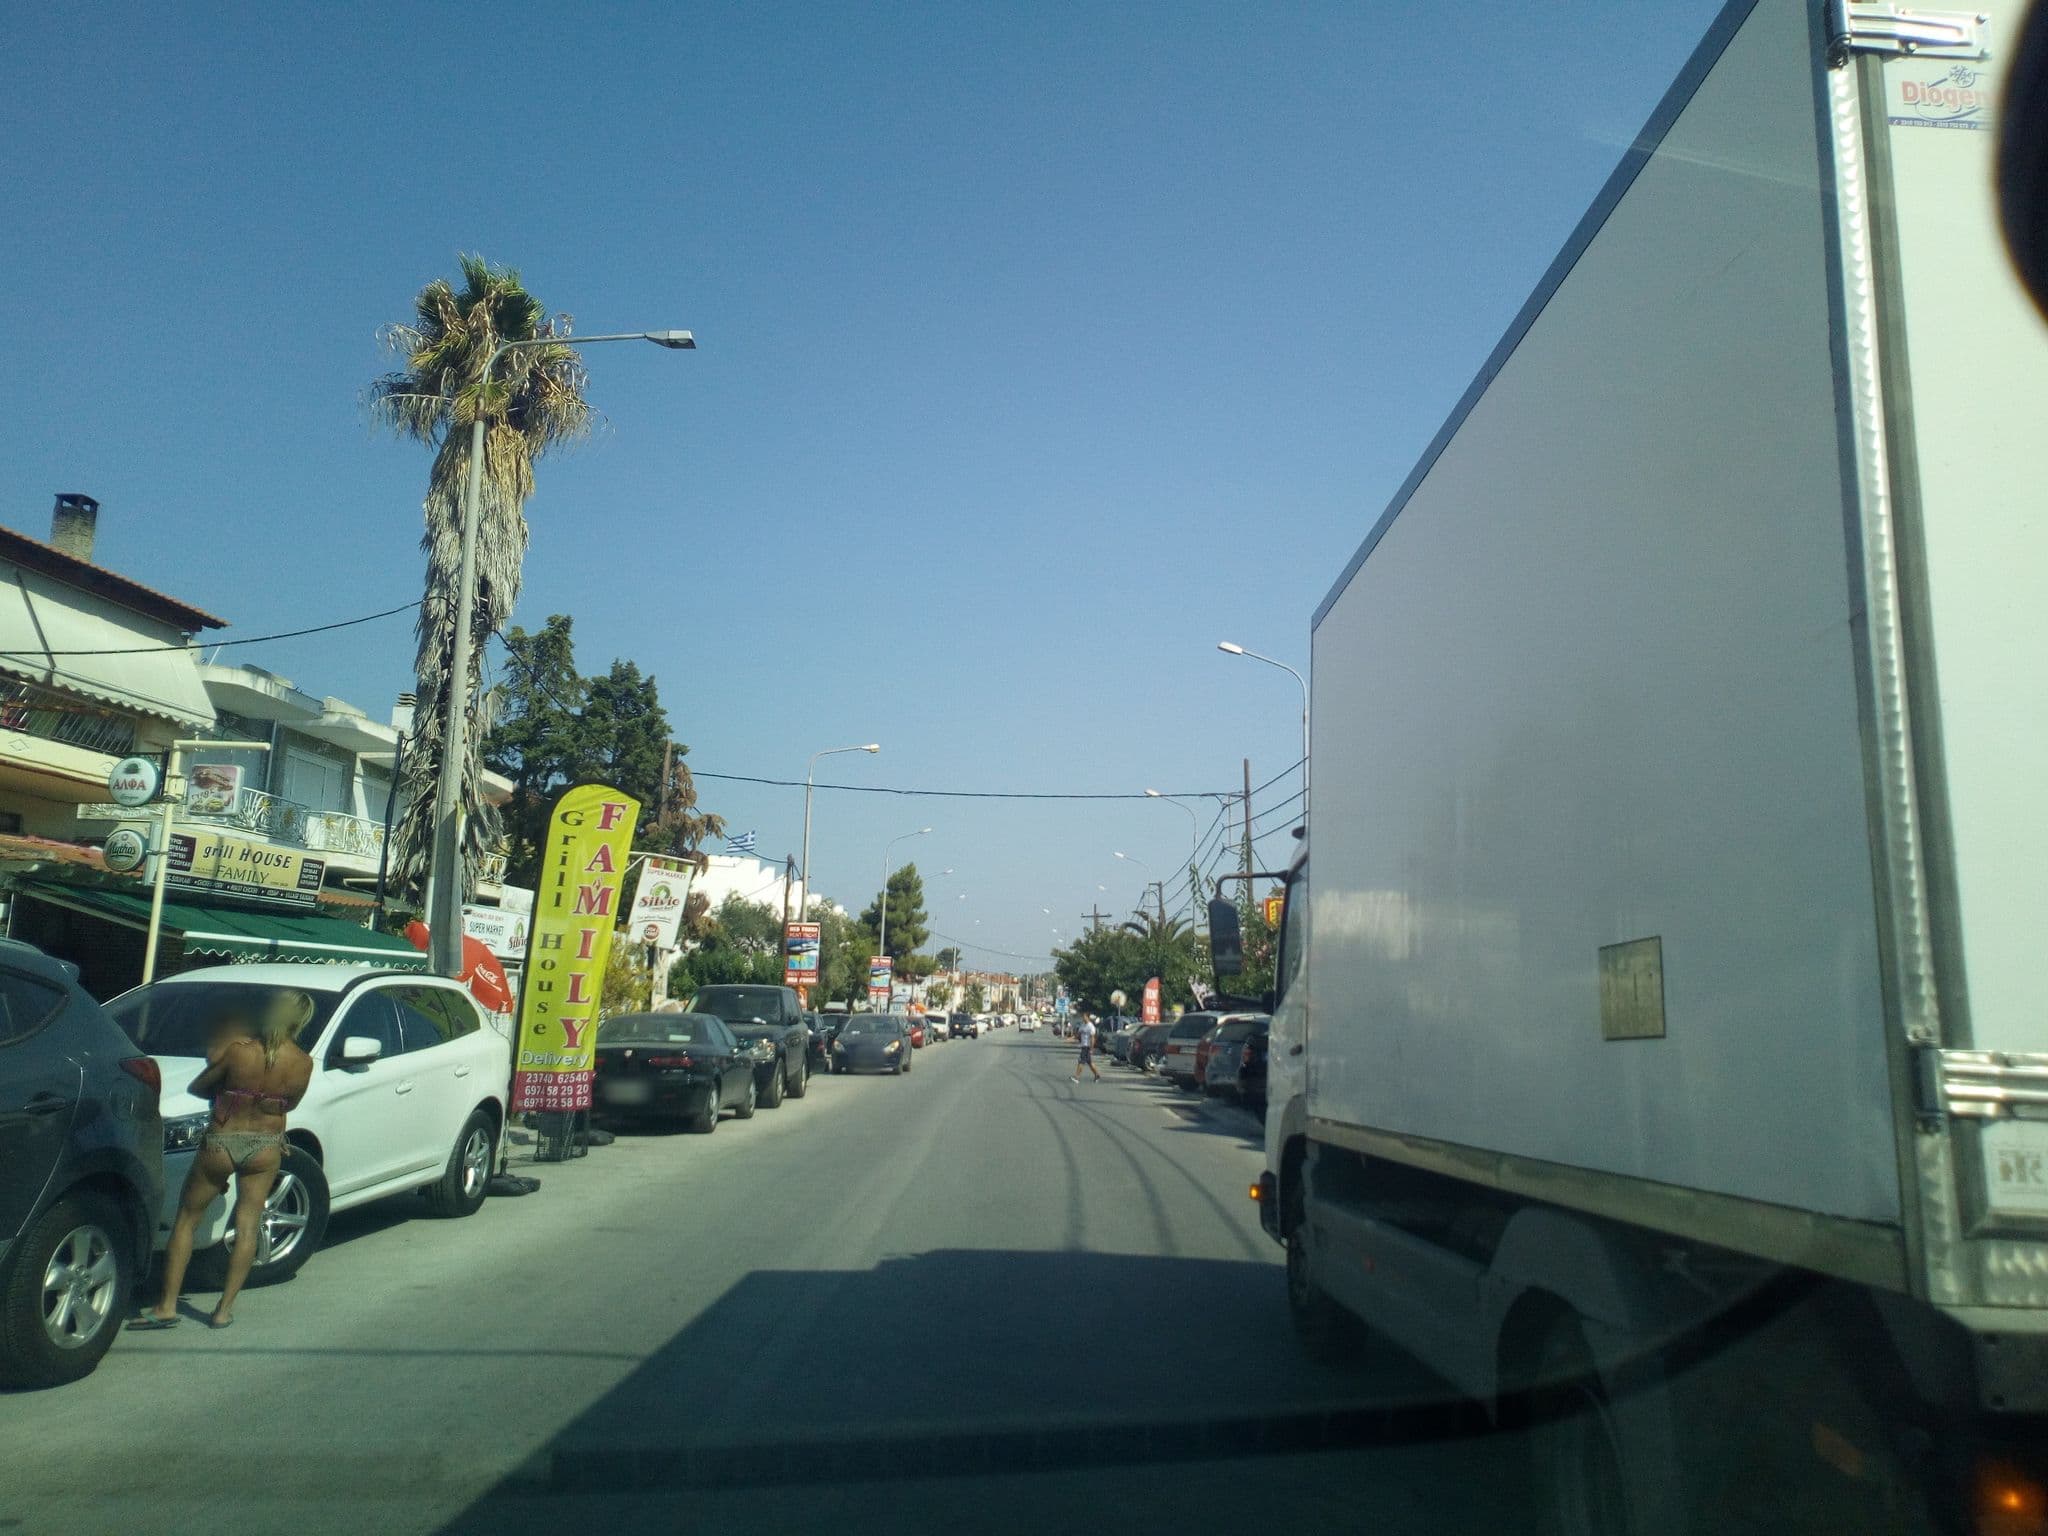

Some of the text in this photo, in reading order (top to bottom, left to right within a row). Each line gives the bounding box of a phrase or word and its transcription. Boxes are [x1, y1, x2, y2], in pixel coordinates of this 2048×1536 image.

[113, 779, 147, 791] ΑΛΦΑ
[203, 845, 234, 859] grill
[239, 848, 293, 869] HOUSE
[215, 864, 270, 884] FAMILY
[469, 921, 504, 936] SUPER MARKET
[532, 810, 585, 1036] Grill House
[559, 802, 628, 1049] FAMILY
[521, 1051, 590, 1068] Delivery
[557, 1071, 589, 1084] 62540
[546, 1085, 558, 1096] 58
[560, 1085, 574, 1096] 29
[576, 1084, 589, 1095] 20
[546, 1097, 558, 1108] 22
[560, 1097, 573, 1108] 58
